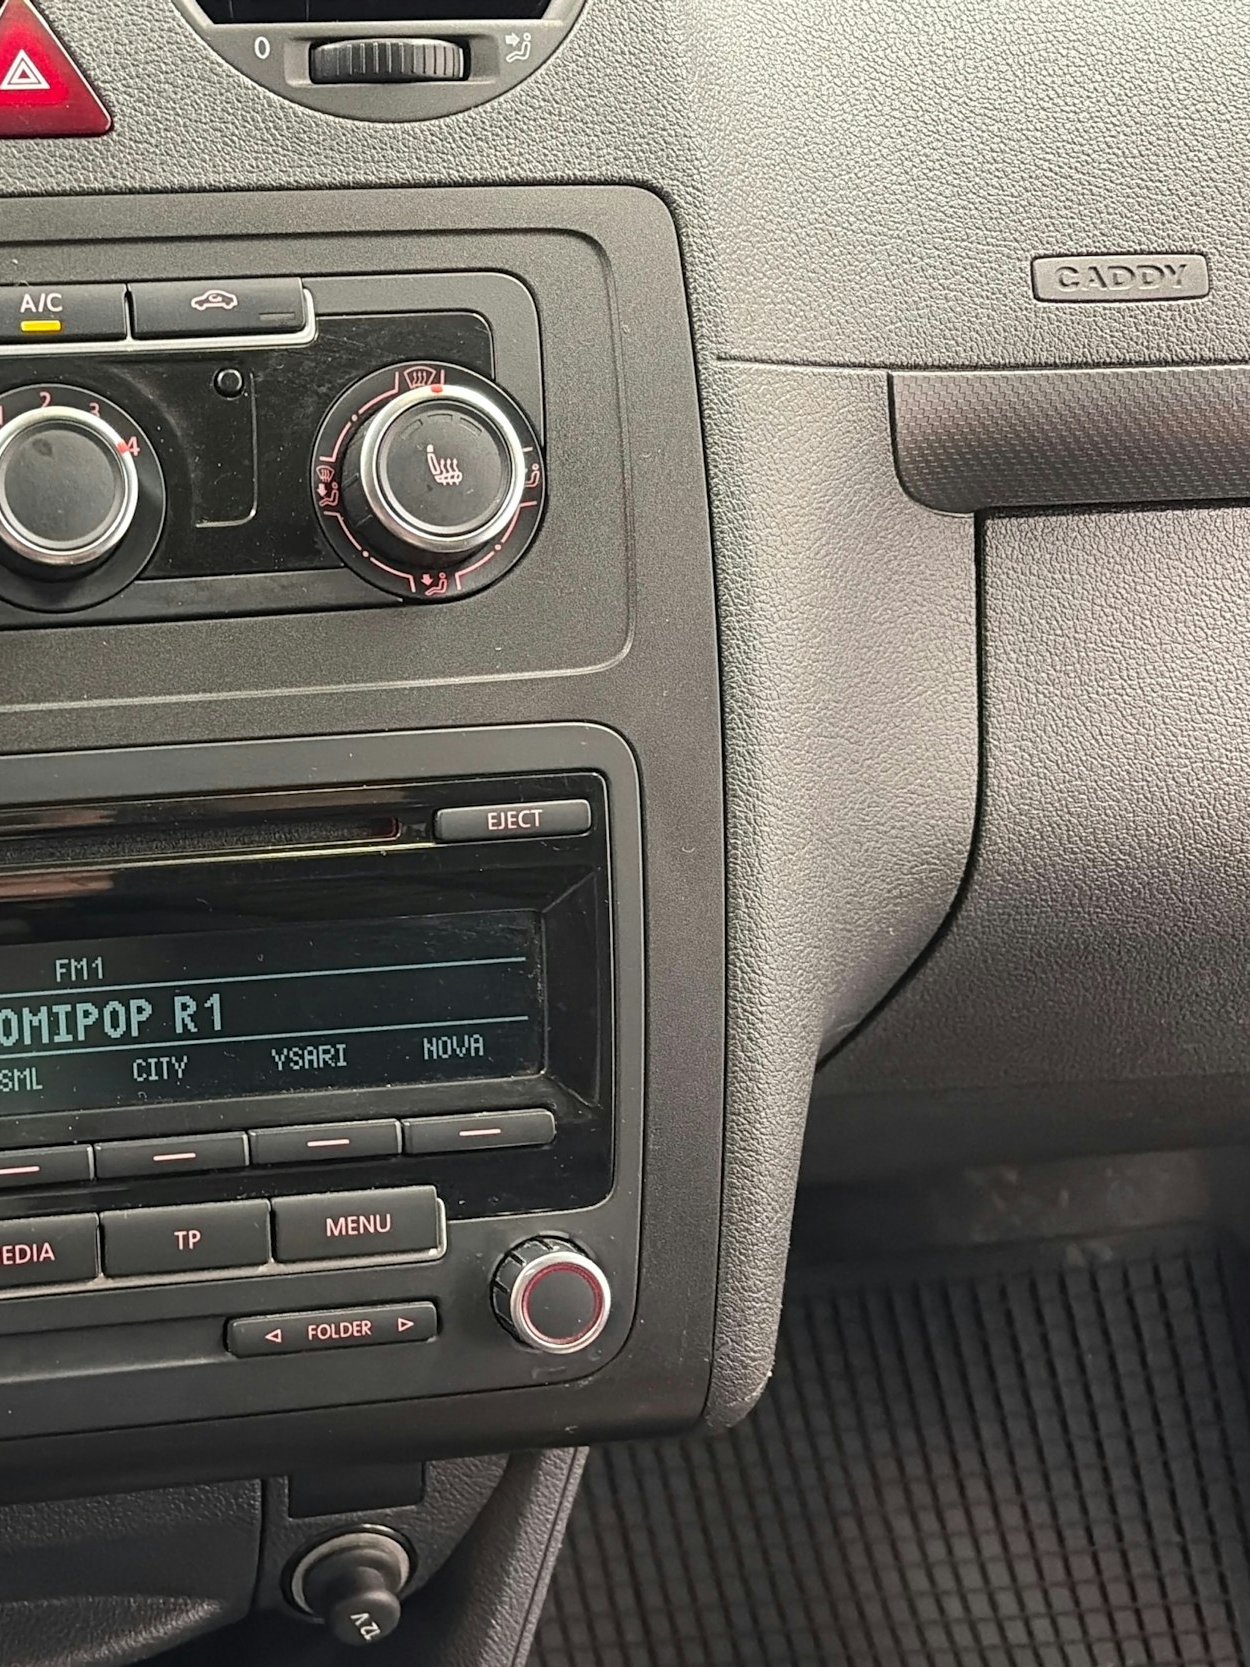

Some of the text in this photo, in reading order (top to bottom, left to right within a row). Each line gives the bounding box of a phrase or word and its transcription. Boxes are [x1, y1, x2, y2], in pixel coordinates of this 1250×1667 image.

[1054, 263, 1188, 293] CADDY
[20, 292, 63, 314] A/C
[487, 809, 543, 831] EJECT
[55, 957, 103, 982] FM1
[173, 993, 222, 1035] R1
[270, 1043, 348, 1072] YSARI
[422, 1033, 485, 1061] NOVA
[132, 1055, 188, 1083] CITY
[325, 1213, 392, 1238] MENU
[173, 1229, 202, 1251] TP
[307, 1319, 373, 1341] FOLDER
